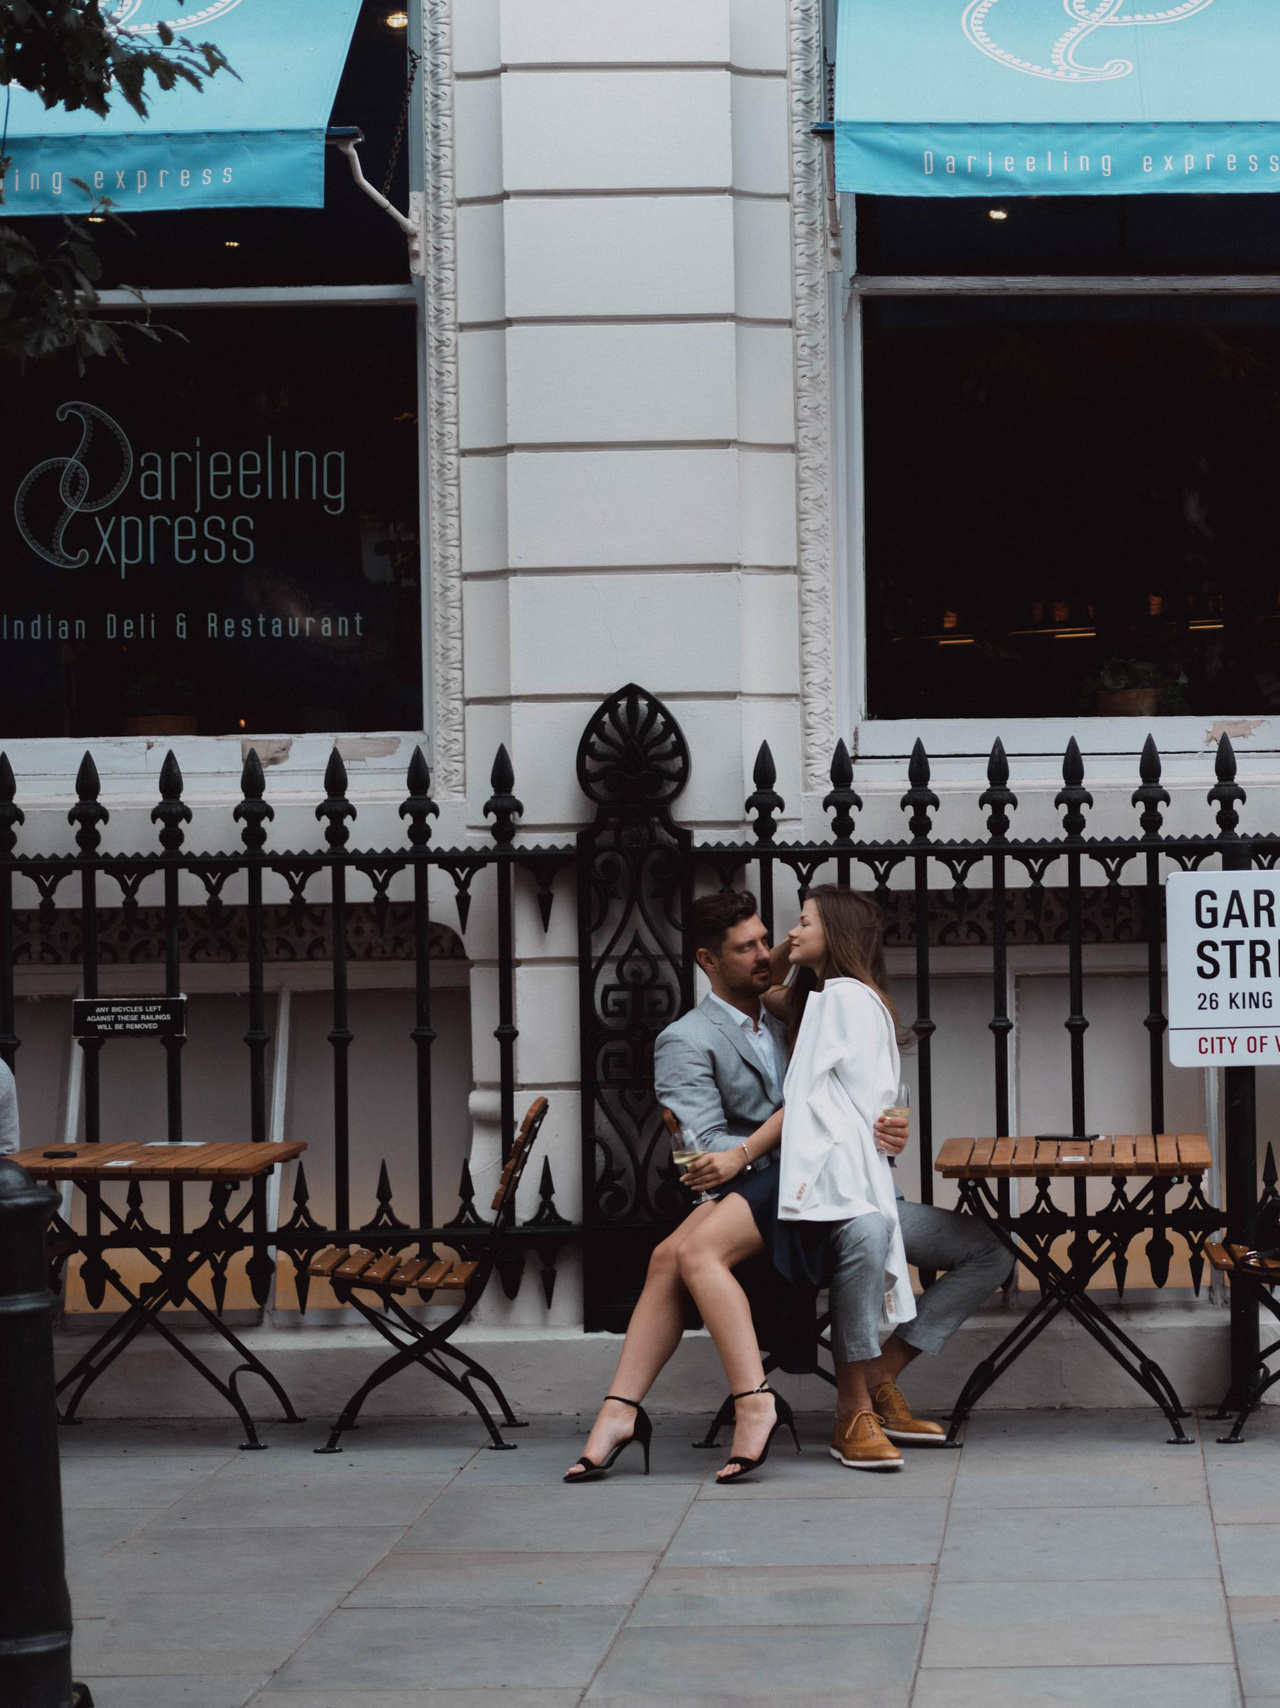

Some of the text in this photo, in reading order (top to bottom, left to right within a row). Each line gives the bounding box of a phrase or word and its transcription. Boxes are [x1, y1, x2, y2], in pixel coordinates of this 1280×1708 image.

[923, 150, 1280, 177] Darjeeling express
[94, 165, 235, 194] express
[3, 611, 364, 640] Indian Deli & Restaurant
[1197, 992, 1219, 1010] 26
[1229, 991, 1273, 1010] KING
[1198, 1036, 1239, 1055] CITY
[1246, 1034, 1268, 1053] OF
